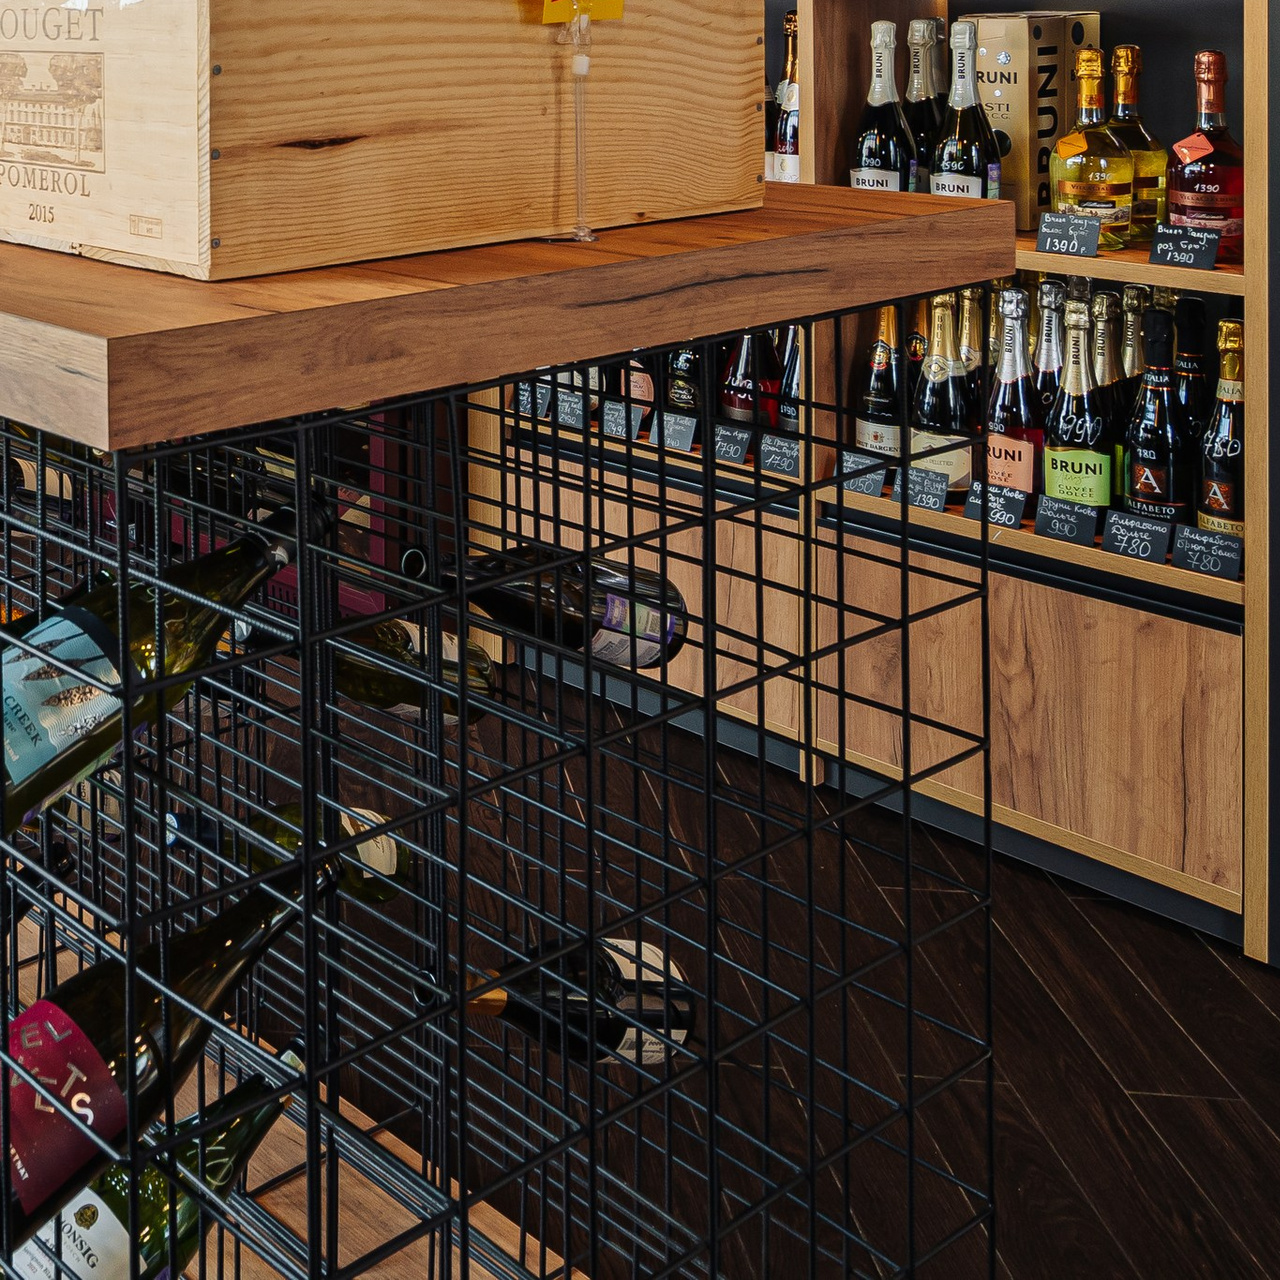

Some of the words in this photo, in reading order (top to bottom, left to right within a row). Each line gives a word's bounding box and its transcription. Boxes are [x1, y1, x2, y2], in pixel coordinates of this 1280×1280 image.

[984, 103, 1010, 111] STI
[856, 178, 889, 188] BRUNI
[935, 183, 970, 193] BRUNI
[1194, 183, 1220, 193] 1390
[28, 203, 54, 223] 2015
[1045, 238, 1078, 253] 1390
[1166, 252, 1194, 264] 1390
[1045, 315, 1053, 343] BRUNI
[1126, 320, 1134, 348] BRUNI
[1005, 325, 1014, 353] BRUNI
[1098, 328, 1106, 357] BRUNI
[1073, 336, 1081, 365] BRUNI
[716, 442, 741, 457] 1790
[987, 449, 1021, 462] RUNI
[765, 454, 793, 471] 1790
[1051, 457, 1103, 476] BRUNI
[1058, 484, 1095, 492] CUVÉE
[1058, 489, 1095, 498] DOLCE
[913, 496, 940, 509] 1390
[1128, 500, 1175, 515] ALFABETO
[988, 509, 1015, 525] 990
[1048, 519, 1077, 537] 990
[1115, 535, 1152, 557] 780
[1186, 551, 1221, 572] 780
[5, 695, 44, 747] CREEK
